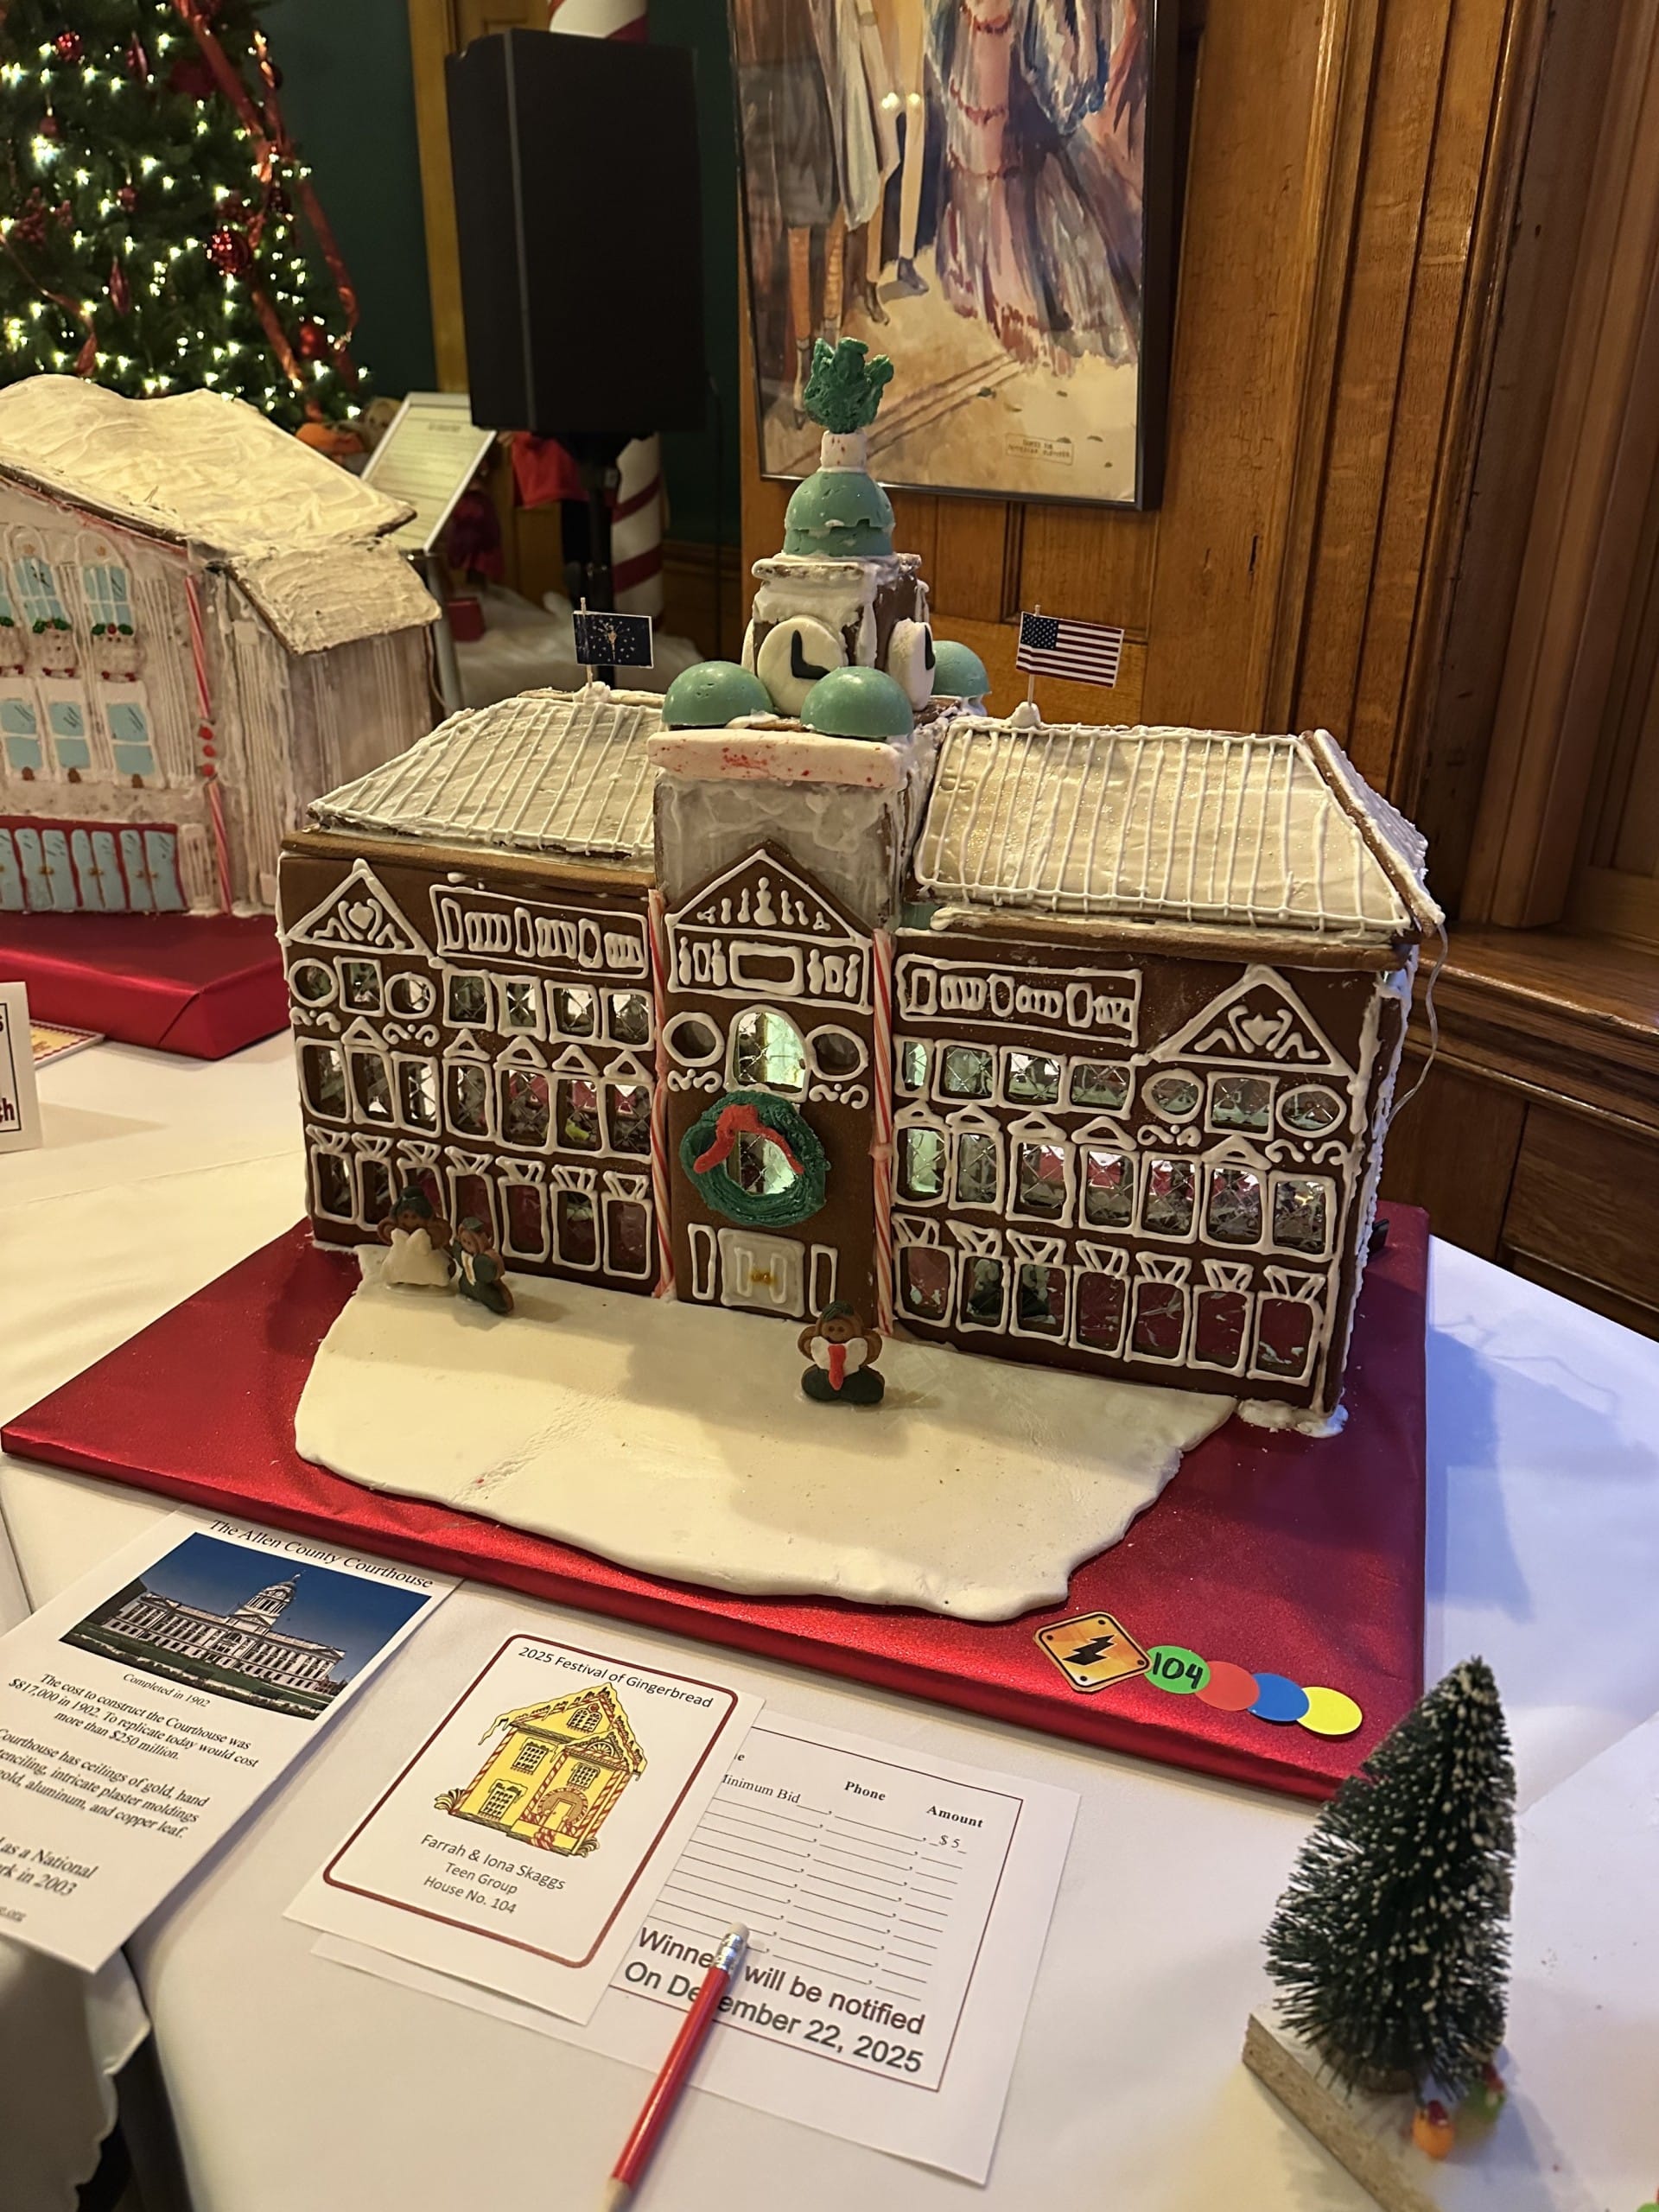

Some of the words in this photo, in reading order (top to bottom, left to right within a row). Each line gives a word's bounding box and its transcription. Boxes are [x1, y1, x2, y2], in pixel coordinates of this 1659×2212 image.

[210, 1520, 238, 1535] The
[238, 1529, 281, 1548] Allen
[284, 1541, 340, 1565] County
[343, 1557, 433, 1588] Courthouse
[123, 1674, 175, 1698] Completed
[175, 1691, 187, 1700] in
[186, 1694, 210, 1707] 1902
[518, 1647, 554, 1663] 2025
[555, 1656, 608, 1679] Festival
[608, 1673, 626, 1684] of
[626, 1676, 714, 1708] Gingerbread
[1152, 1651, 1204, 1689] 104
[9, 1678, 60, 1702] $817,000
[58, 1695, 69, 1707] in
[71, 1700, 99, 1718] 1902.
[104, 1710, 119, 1723] To
[119, 1718, 165, 1739] replicate
[166, 1733, 198, 1751] today
[199, 1742, 235, 1760] would
[234, 1754, 259, 1768] cost
[41, 1674, 61, 1688] The
[61, 1682, 84, 1696] cost
[86, 1690, 97, 1700] to
[98, 1694, 146, 1717] construct
[146, 1710, 164, 1723] the
[166, 1718, 228, 1743] Courthouse
[228, 1737, 251, 1750] was
[54, 1712, 84, 1728] more
[86, 1721, 108, 1736] than
[109, 1730, 140, 1746] $250
[138, 1738, 180, 1760] million.
[50, 1766, 101, 1793] intricate
[99, 1786, 143, 1806] plaster
[142, 1799, 200, 1823] moldings
[59, 1751, 81, 1766] has
[81, 1759, 128, 1783] ceilings
[128, 1777, 146, 1788] of
[141, 1783, 175, 1799] gold,
[175, 1789, 210, 1808] hand
[777, 1788, 801, 1804] Bid
[843, 1781, 887, 1802] Phone
[925, 1805, 984, 1828] Amount
[25, 1779, 87, 1810] aluminum,
[89, 1802, 118, 1817] and
[115, 1811, 158, 1828] copper
[157, 1821, 188, 1839] leaf.
[0, 1843, 20, 1855] as
[18, 1849, 31, 1859] a
[30, 1848, 99, 1878] National
[16, 1867, 35, 1884] in
[33, 1873, 77, 1896] 2003
[421, 1834, 466, 1857] Farrah
[468, 1849, 480, 1862] &
[483, 1853, 515, 1872] Iona
[516, 1864, 566, 1891] Skaggs
[445, 1862, 475, 1881] Teen
[478, 1873, 518, 1895] Group
[423, 1875, 464, 1897] House
[466, 1889, 486, 1905] No.
[490, 1897, 517, 1914] 104
[624, 1961, 662, 1989] On
[667, 1974, 802, 2034] Deember
[804, 2018, 843, 2053] 22,
[853, 2035, 925, 2074] 2025
[744, 1966, 785, 1990] will
[788, 1976, 823, 2003] be
[828, 1990, 925, 2035] notified
